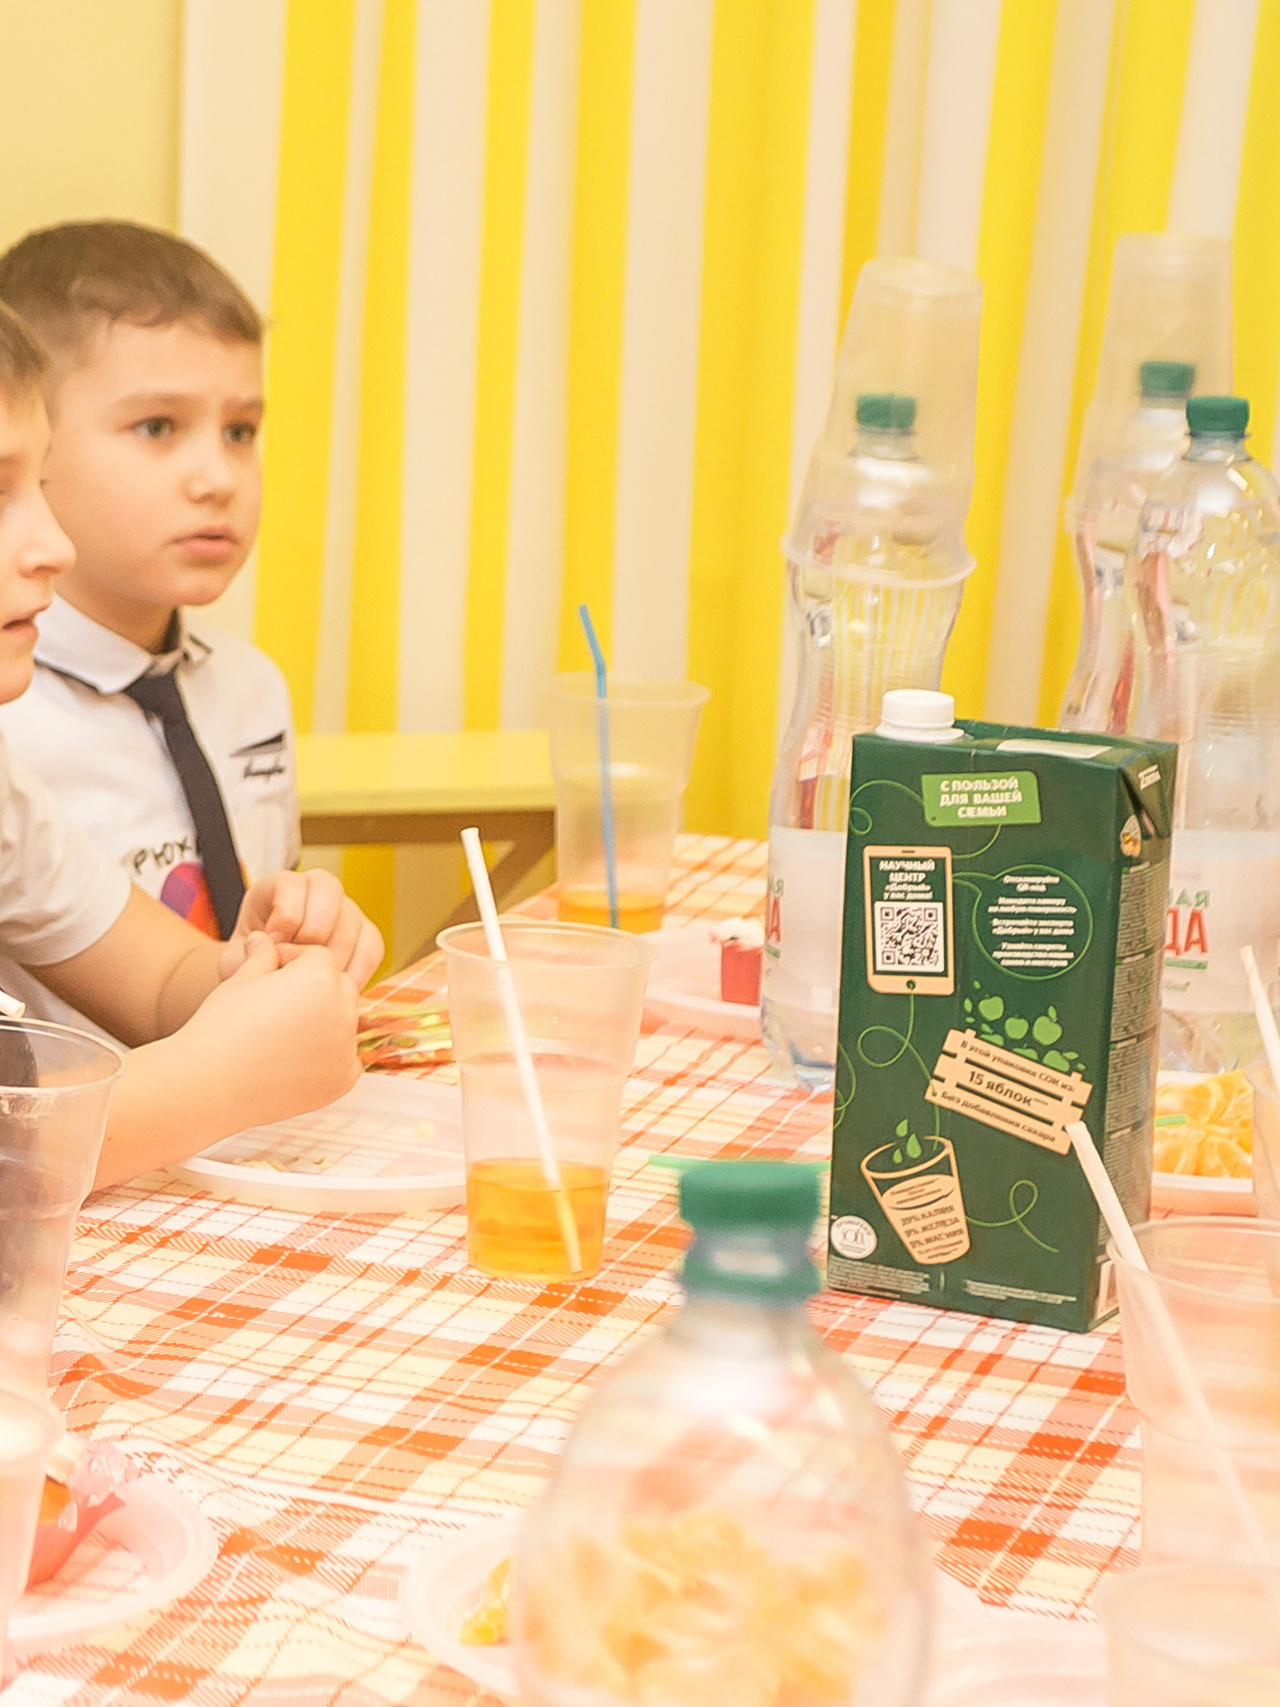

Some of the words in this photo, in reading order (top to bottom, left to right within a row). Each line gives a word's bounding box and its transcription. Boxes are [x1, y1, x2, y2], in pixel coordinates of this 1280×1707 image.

[940, 780, 949, 792] С
[952, 776, 1018, 791] ПОЛЬЗОЙ
[940, 793, 968, 807] ДЛЯ
[973, 789, 1022, 804] ВАШЕЙ
[957, 806, 1007, 819] СЕМЬИ
[879, 859, 935, 871] НАУЧНЫЙ
[889, 872, 926, 883] ЦЕНТР
[969, 1070, 984, 1085] 15
[941, 1091, 960, 1103] Без
[1021, 1124, 1056, 1143] сахара
